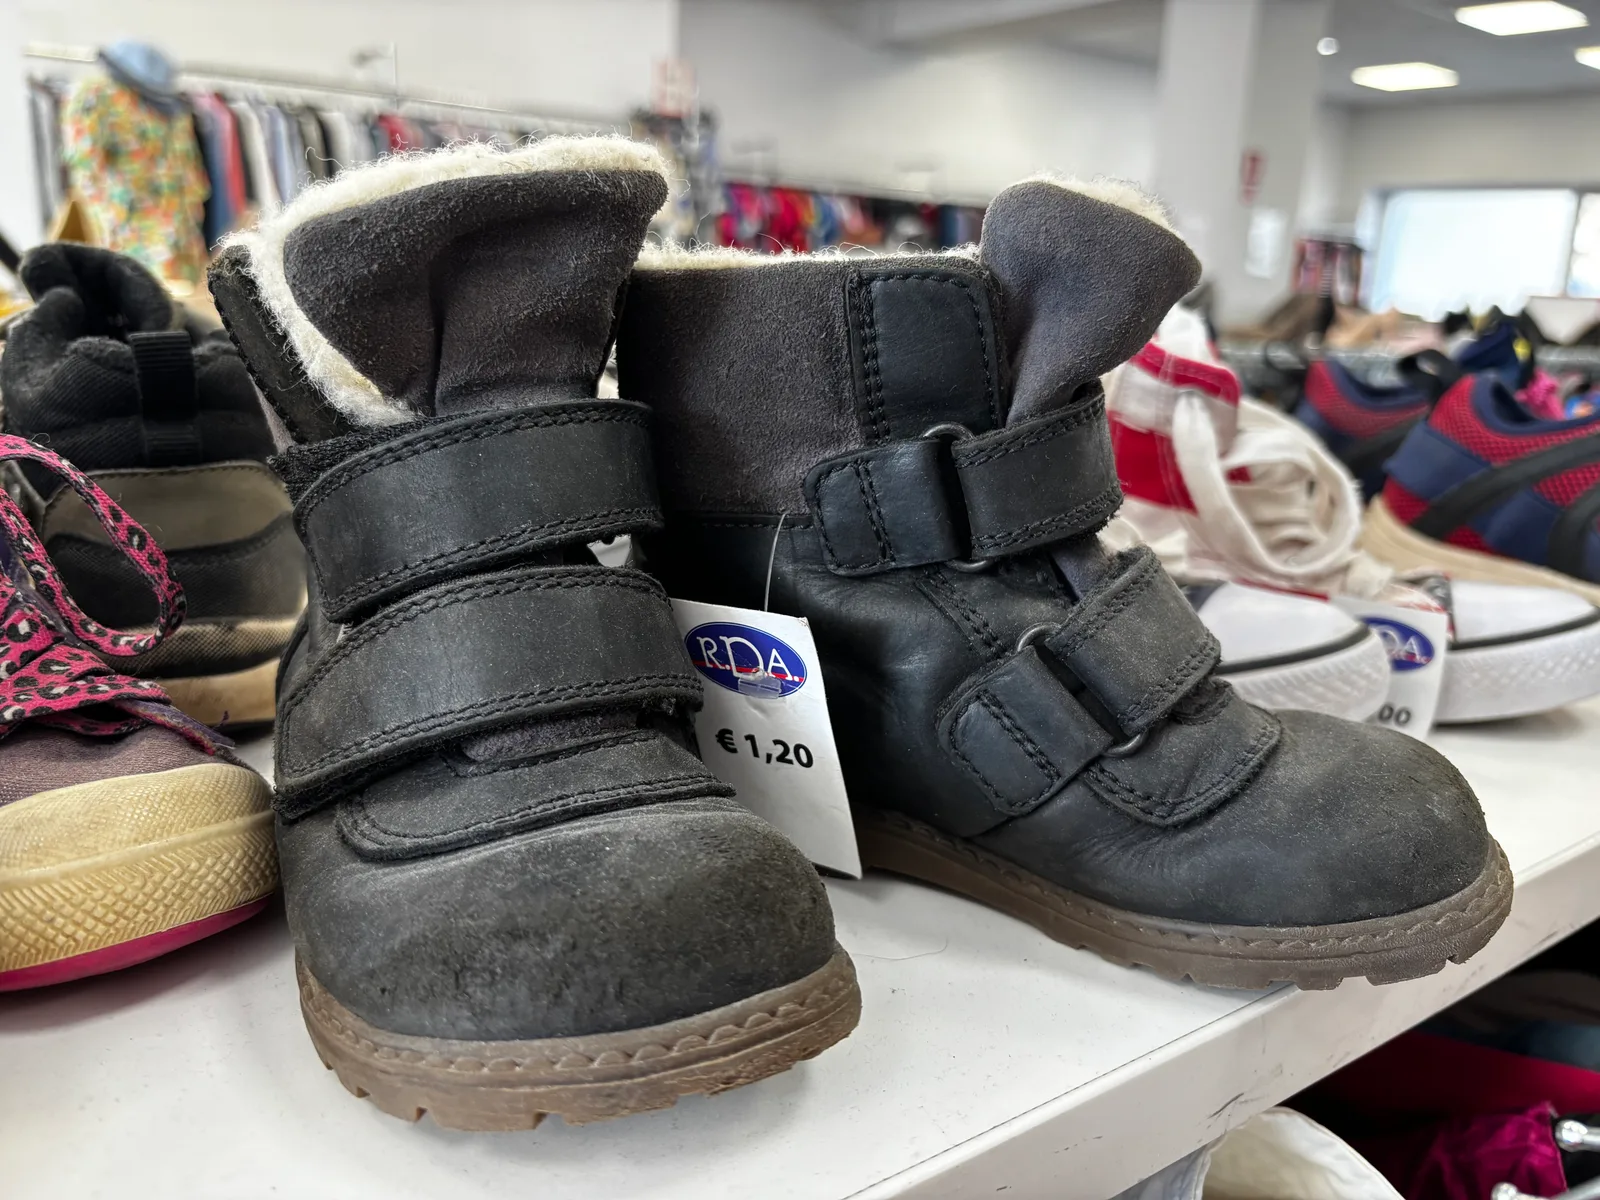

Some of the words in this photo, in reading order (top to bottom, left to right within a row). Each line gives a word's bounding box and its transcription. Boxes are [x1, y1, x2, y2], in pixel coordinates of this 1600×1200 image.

[1377, 703, 1411, 726] 00
[715, 728, 738, 754] €
[743, 734, 814, 768] 1,20
